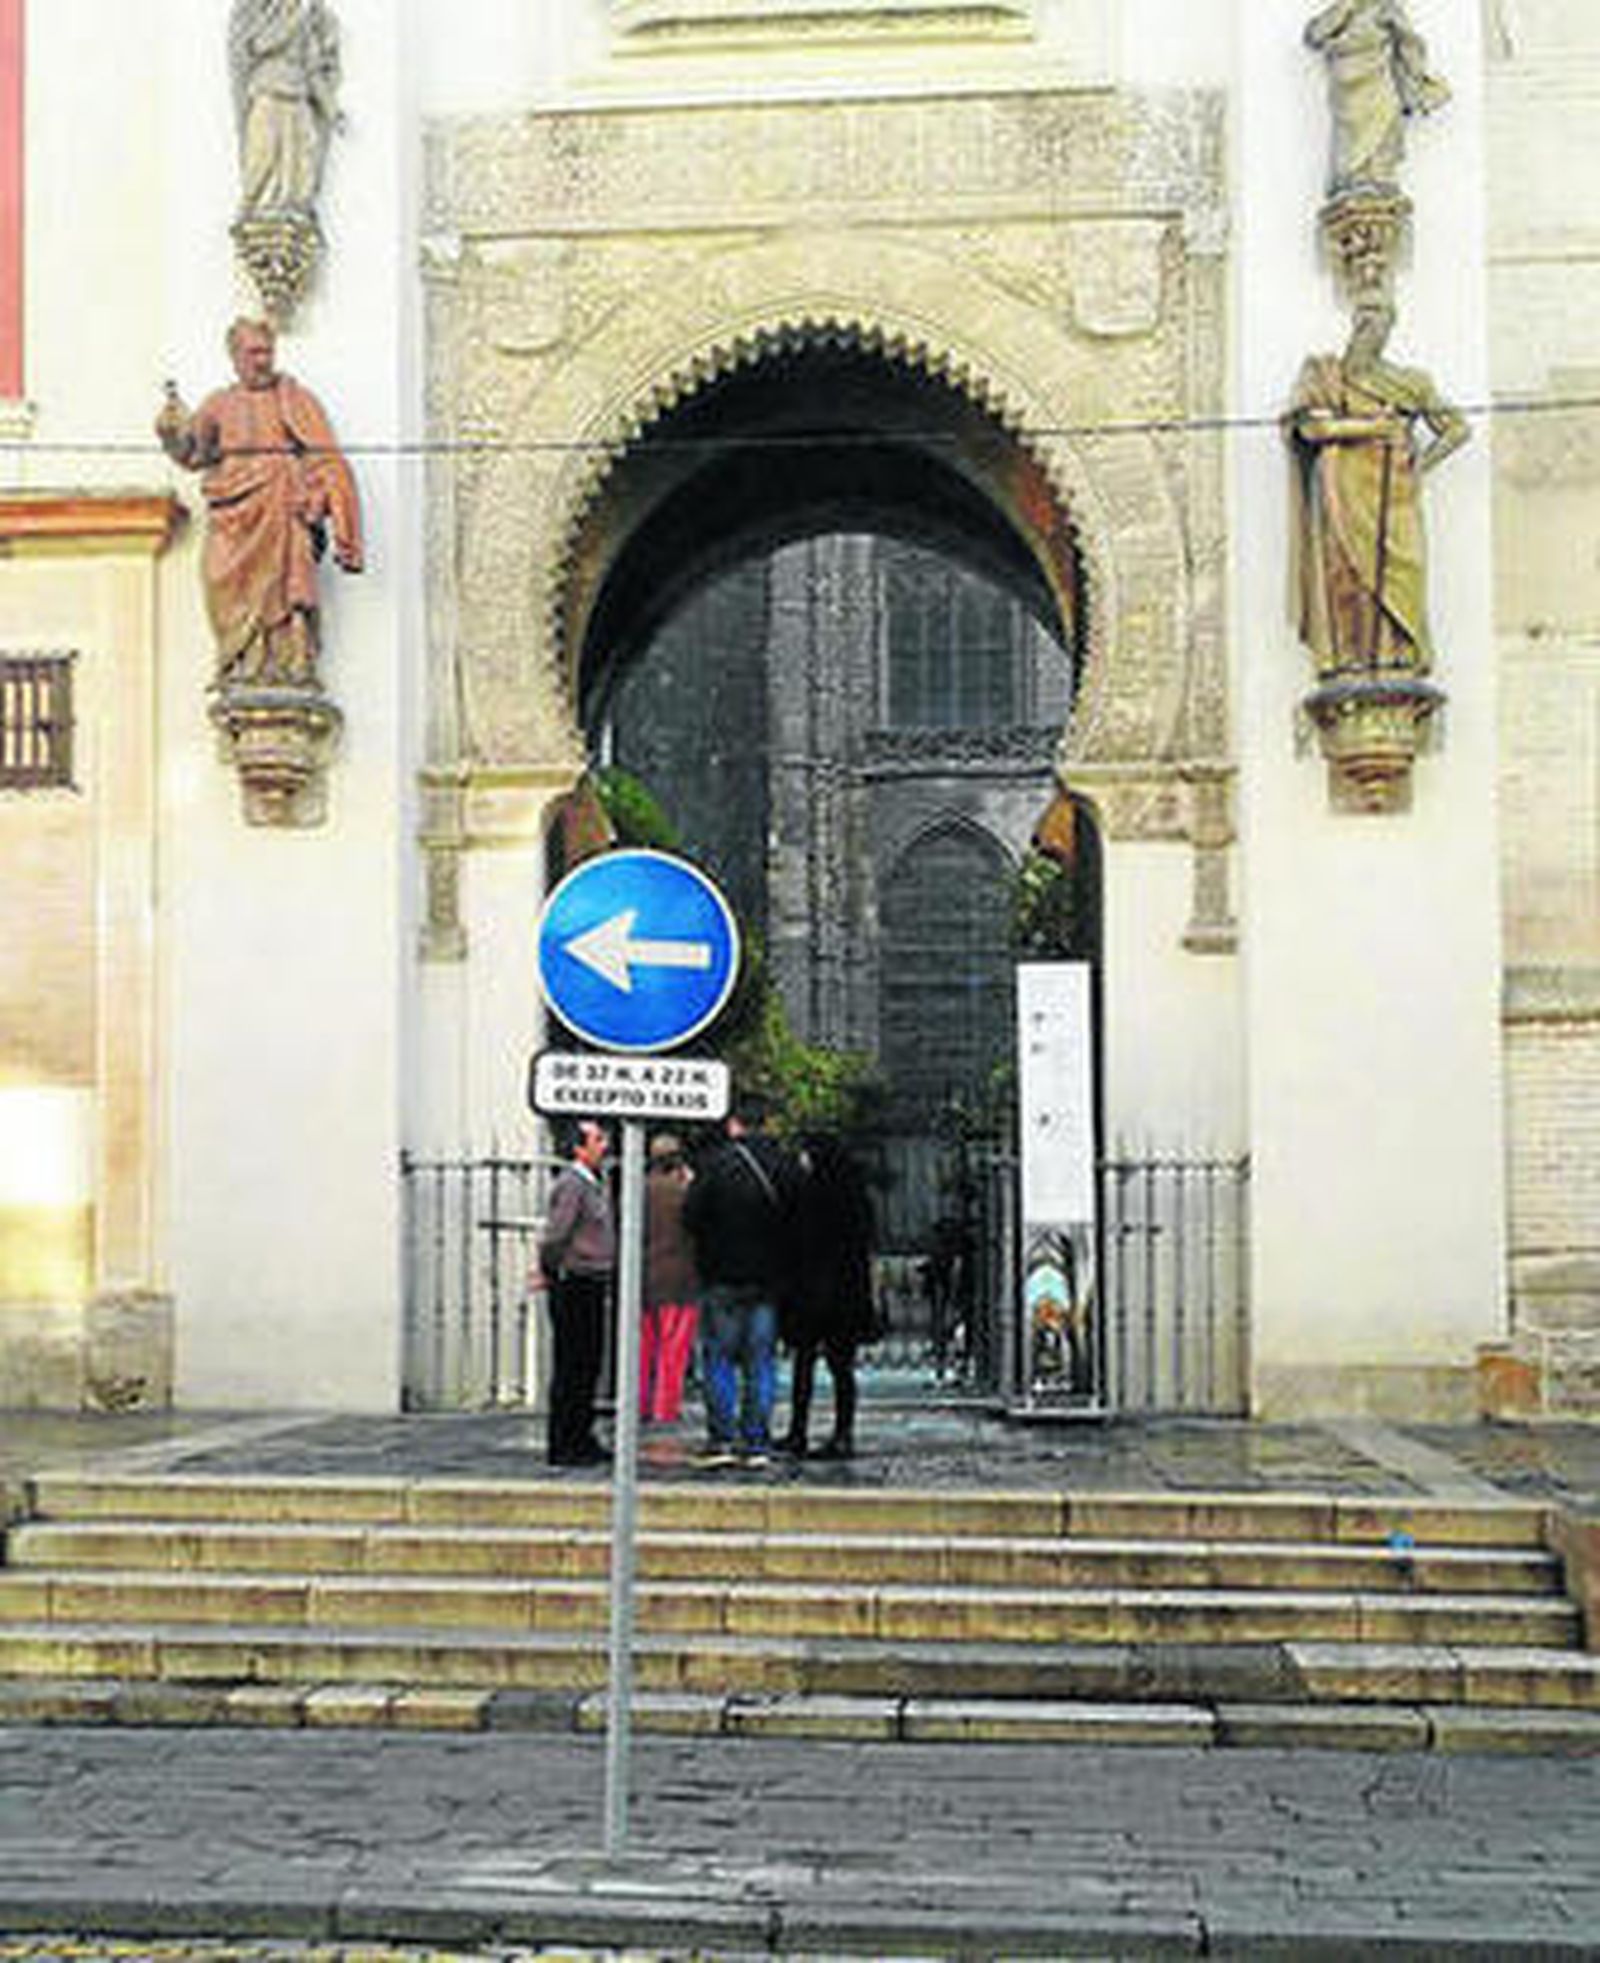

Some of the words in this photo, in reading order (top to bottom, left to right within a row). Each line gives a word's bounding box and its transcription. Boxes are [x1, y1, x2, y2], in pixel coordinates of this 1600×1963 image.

[553, 1063, 579, 1080] DE
[642, 1068, 655, 1083] A
[553, 1087, 646, 1107] EXCEPTO
[651, 1090, 709, 1110] TAXIS
